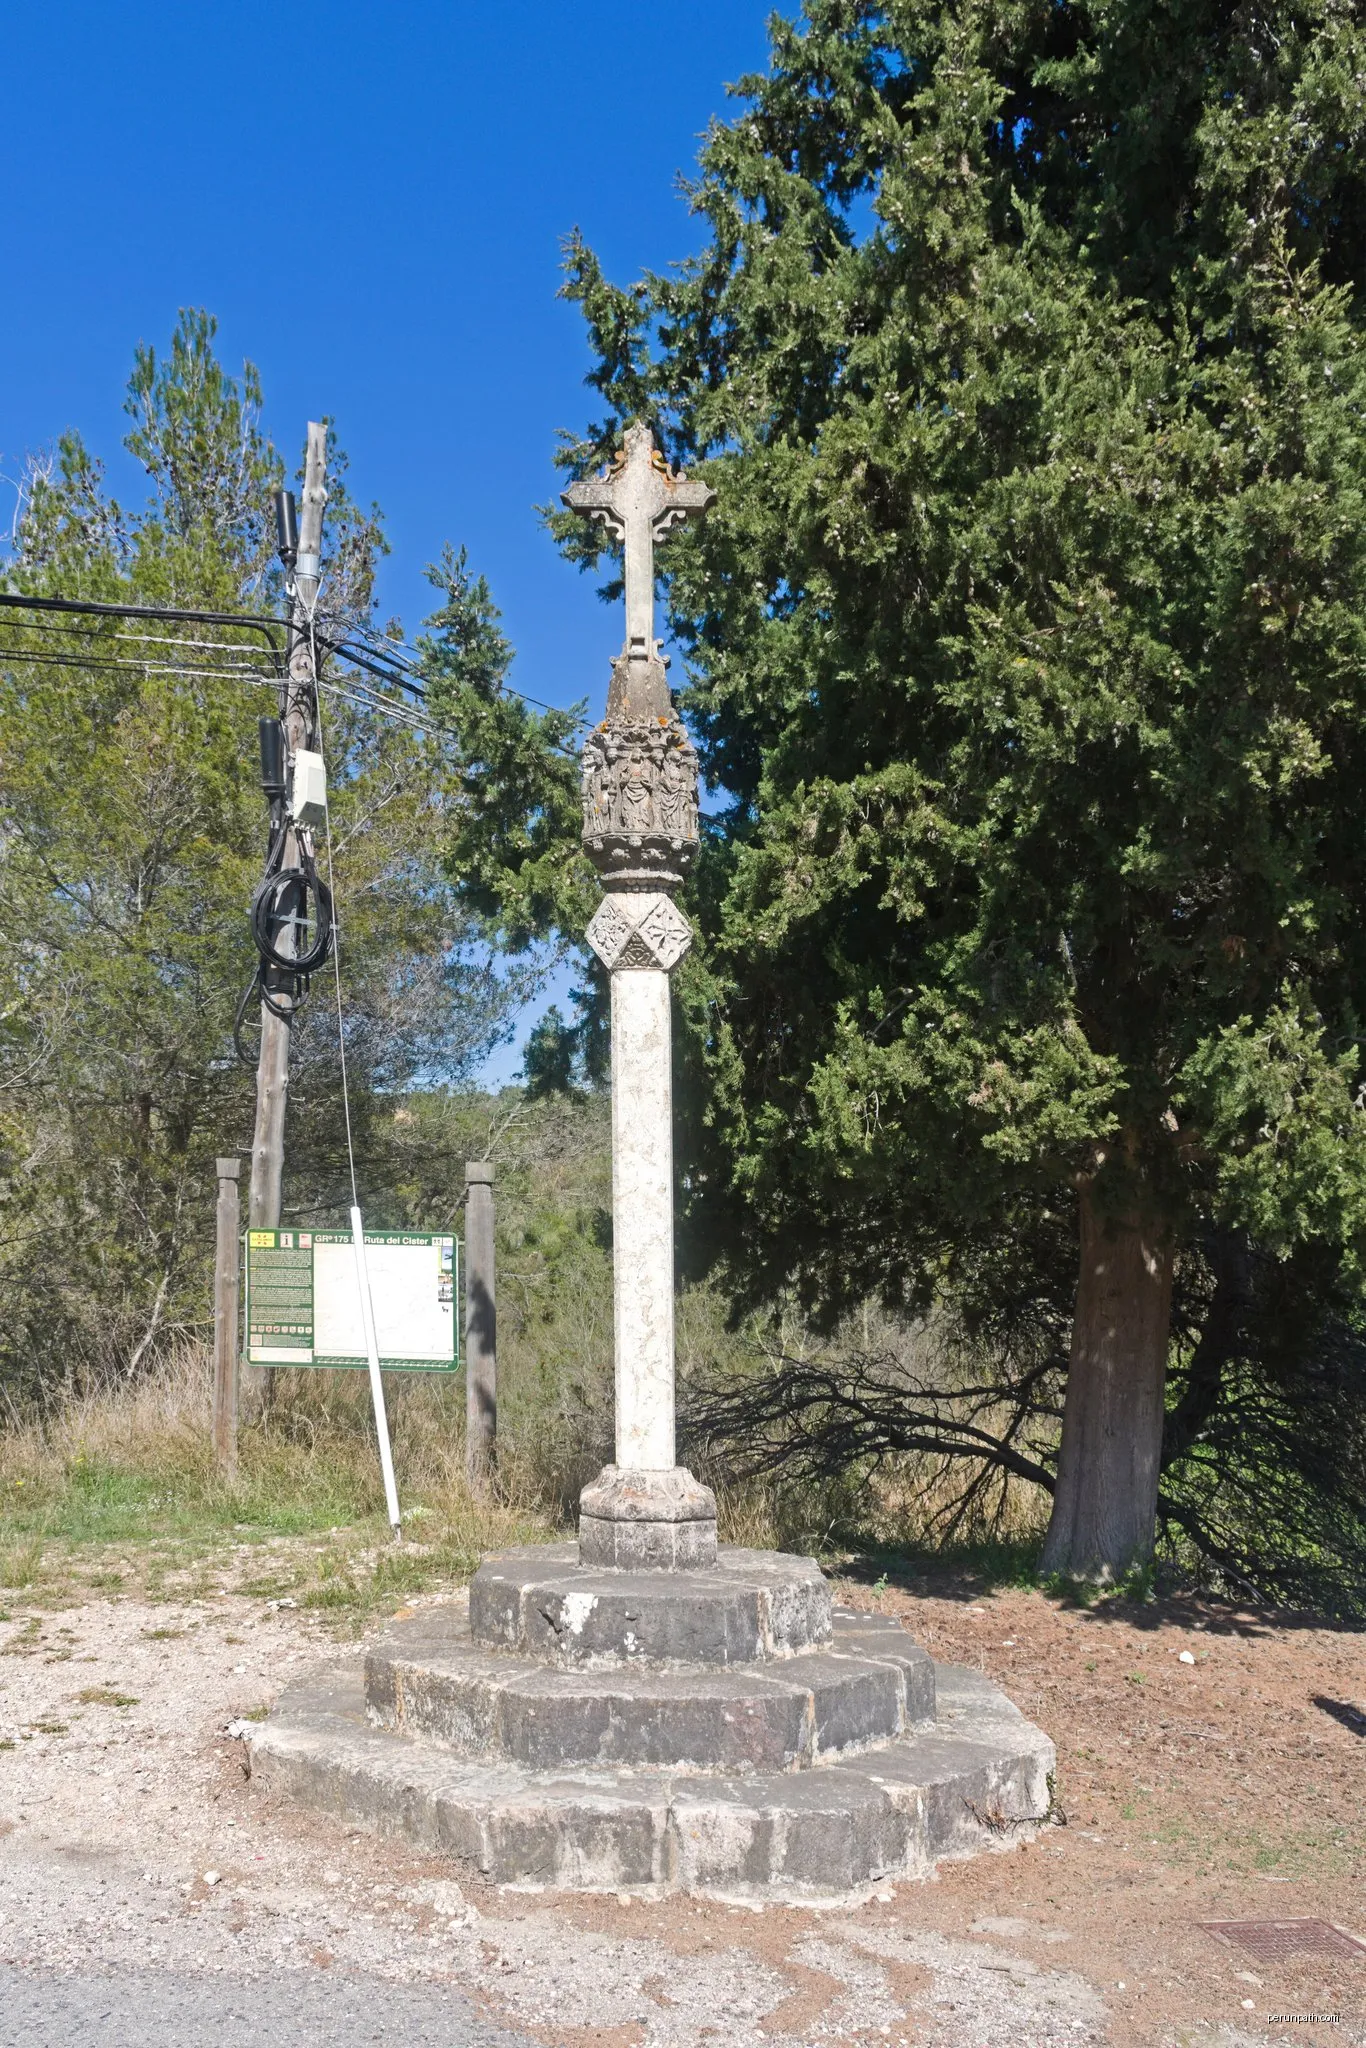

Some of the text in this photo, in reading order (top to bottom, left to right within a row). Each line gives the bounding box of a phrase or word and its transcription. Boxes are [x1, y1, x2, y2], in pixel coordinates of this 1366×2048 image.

[365, 1236, 384, 1244] Ruta
[386, 1236, 400, 1244] del
[402, 1237, 428, 1245] Cister
